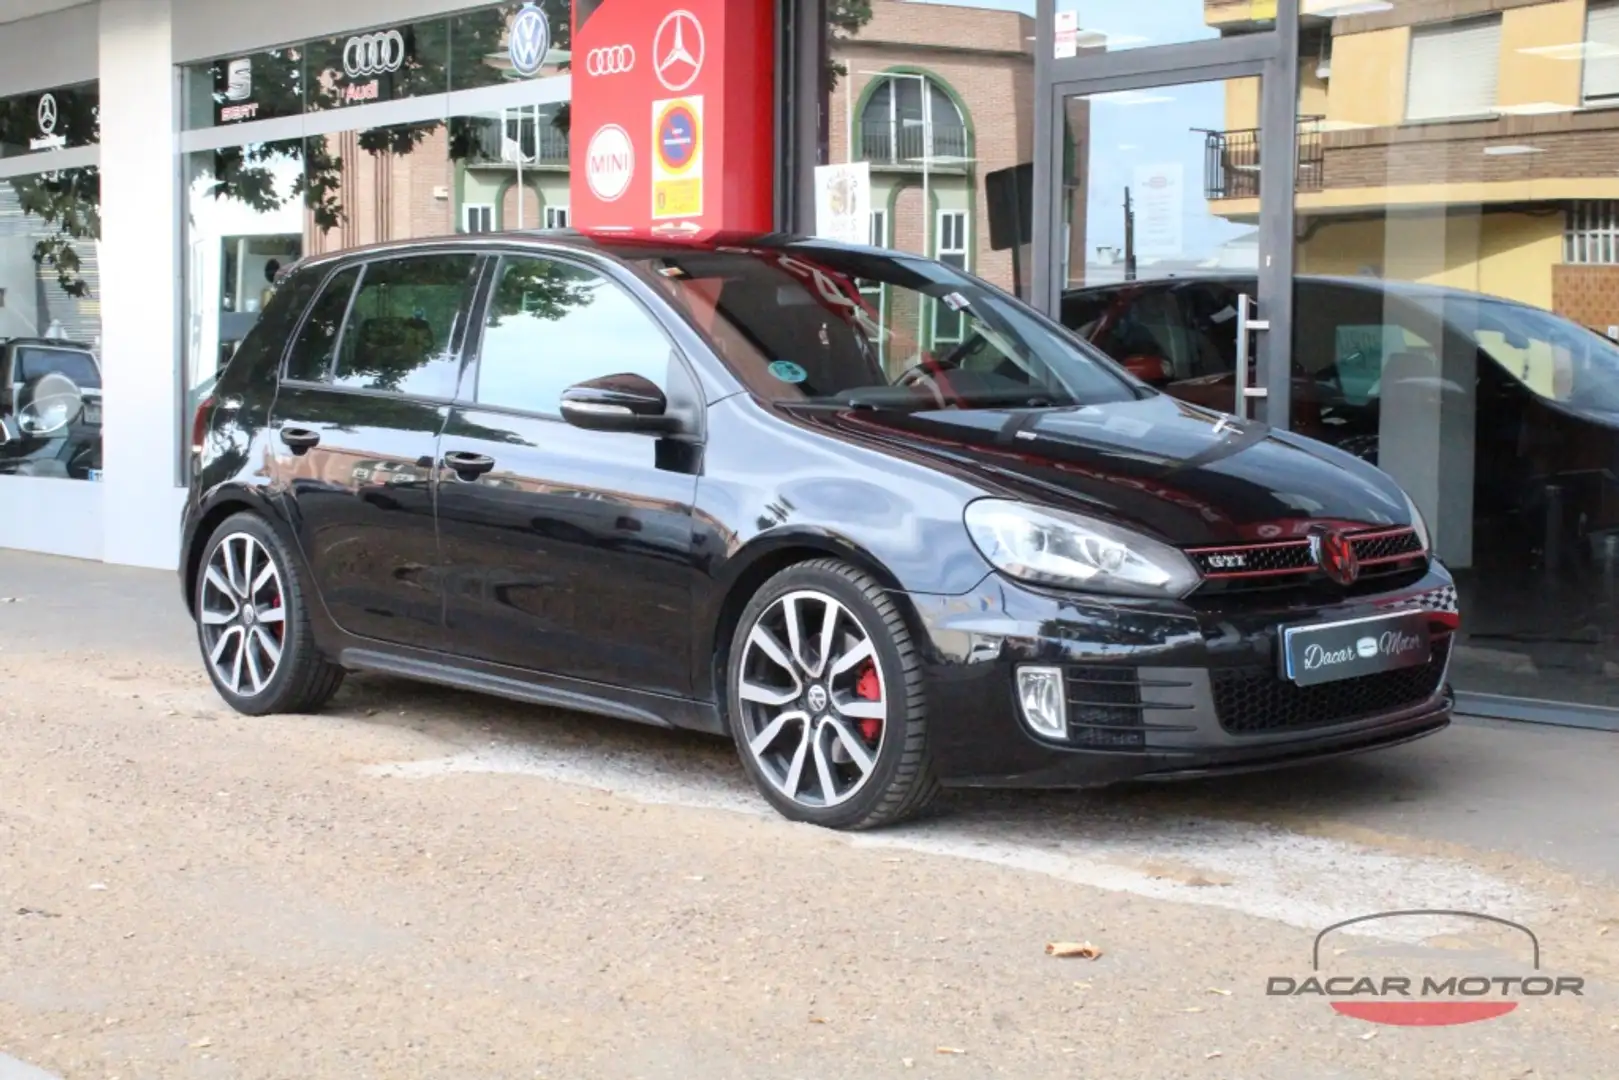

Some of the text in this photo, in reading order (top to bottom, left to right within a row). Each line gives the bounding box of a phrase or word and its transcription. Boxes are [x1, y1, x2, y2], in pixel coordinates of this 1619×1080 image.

[345, 79, 378, 103] Audi
[591, 152, 628, 174] MINI
[1208, 554, 1246, 568] GTI
[1304, 643, 1356, 670] Dacar
